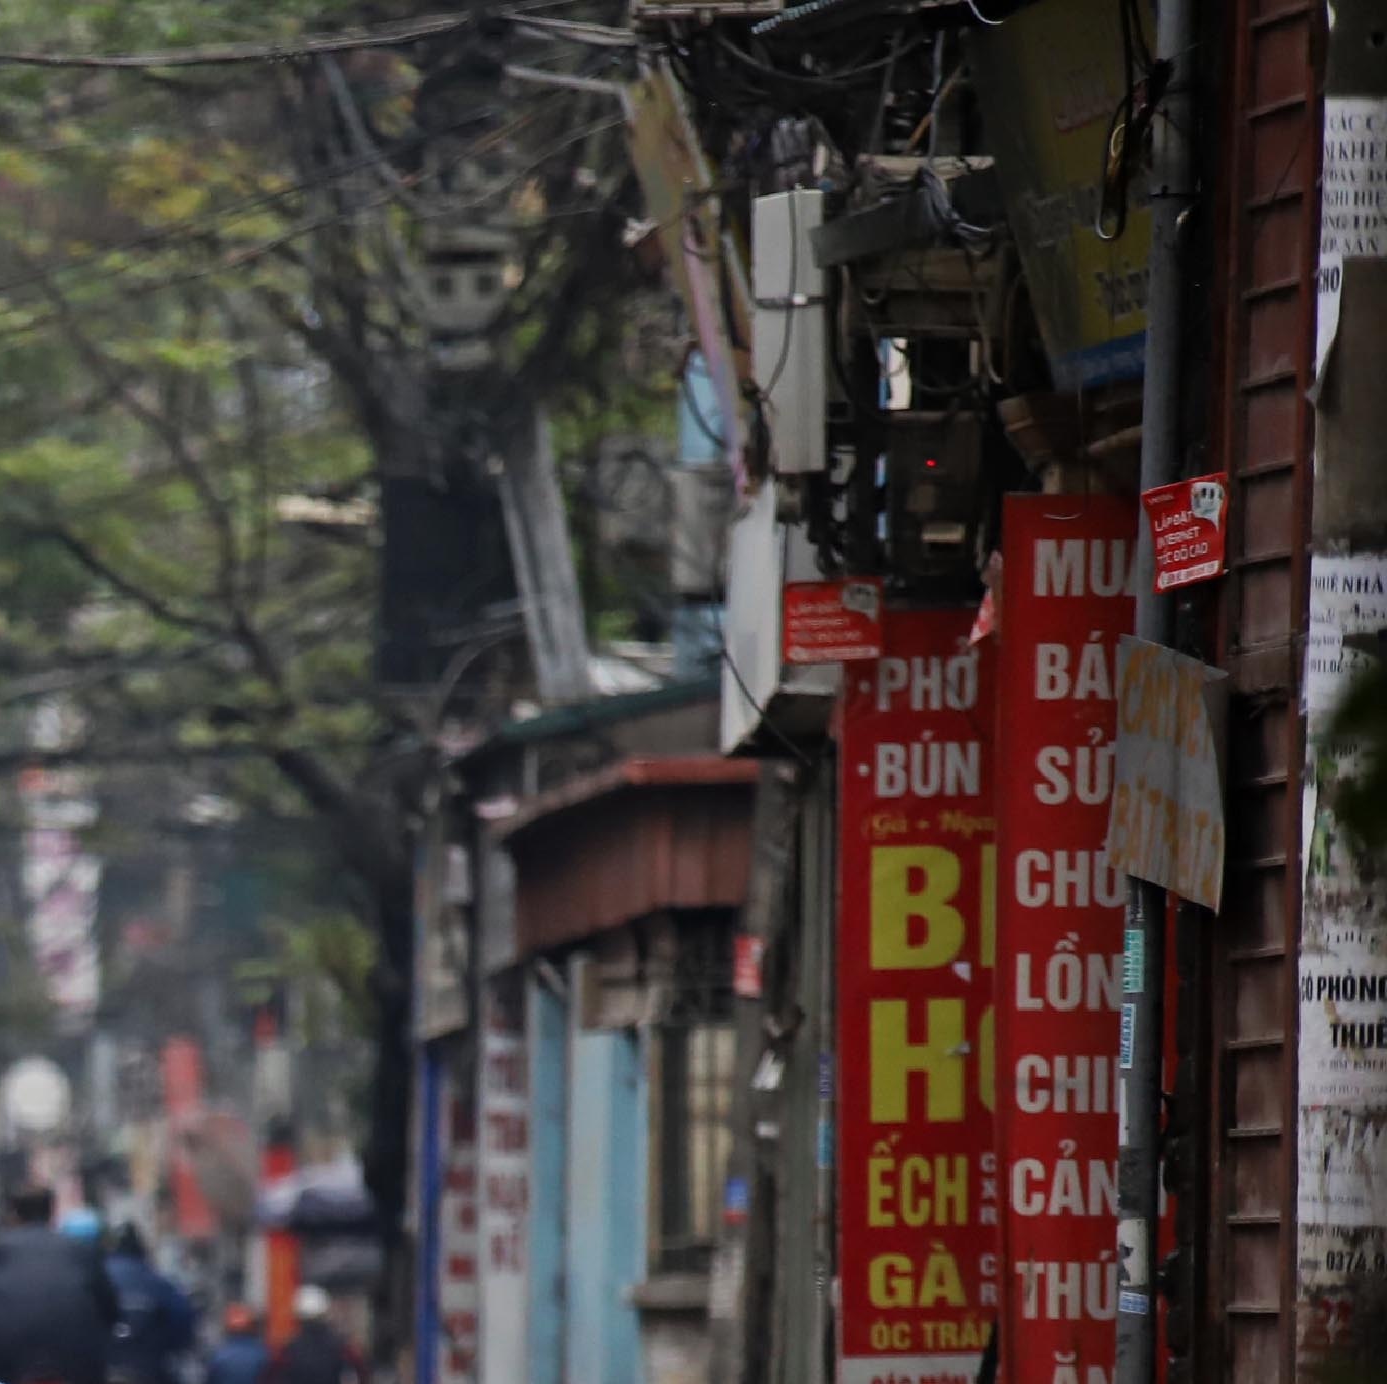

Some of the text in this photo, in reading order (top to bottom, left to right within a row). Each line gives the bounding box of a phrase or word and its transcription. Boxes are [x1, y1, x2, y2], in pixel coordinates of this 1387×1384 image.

[878, 635, 980, 712] PHỞ
[1034, 631, 1119, 700] BÁ
[875, 730, 981, 798] BÚN
[1015, 1054, 1119, 1113] CHI
[868, 1131, 968, 1228] ẾCH
[1012, 1138, 1119, 1217] CẢN
[868, 1240, 968, 1309] GÀ
